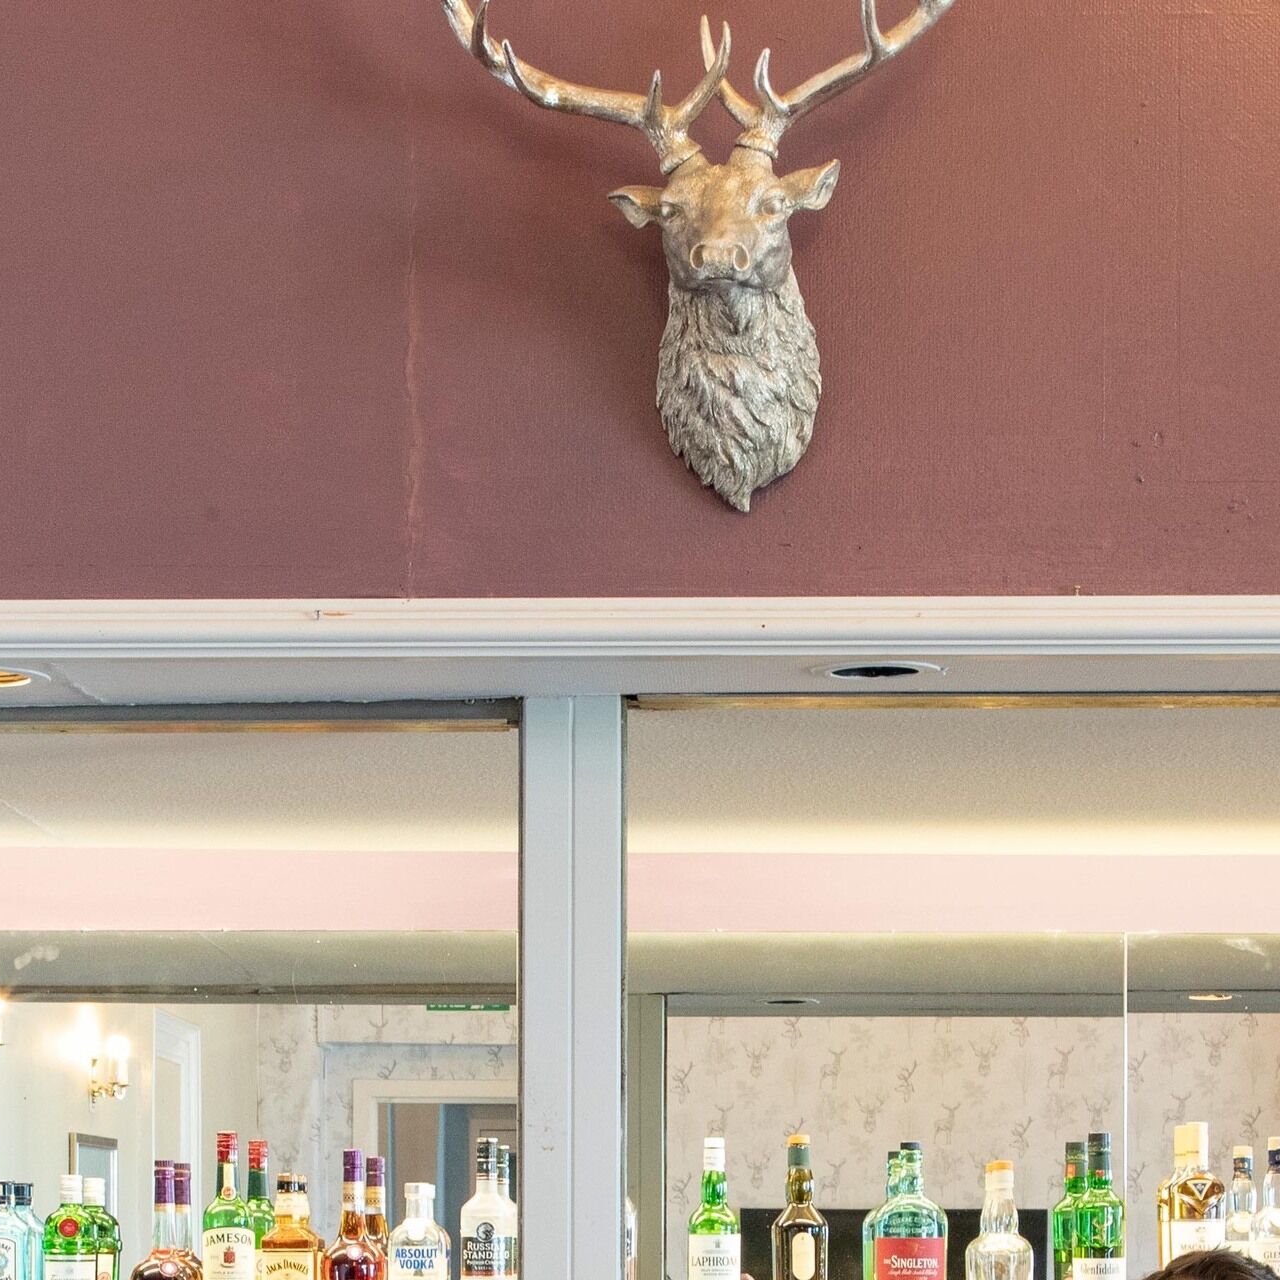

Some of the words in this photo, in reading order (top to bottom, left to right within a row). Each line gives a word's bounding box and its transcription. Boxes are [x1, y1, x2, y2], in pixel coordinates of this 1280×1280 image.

[205, 1232, 252, 1246] JAMESON
[395, 1248, 438, 1259] ABSOLUT
[463, 1250, 510, 1260] STANDARD
[265, 1262, 283, 1274] JACK
[400, 1259, 434, 1269] VODKA
[891, 1257, 938, 1268] SINGLETON
